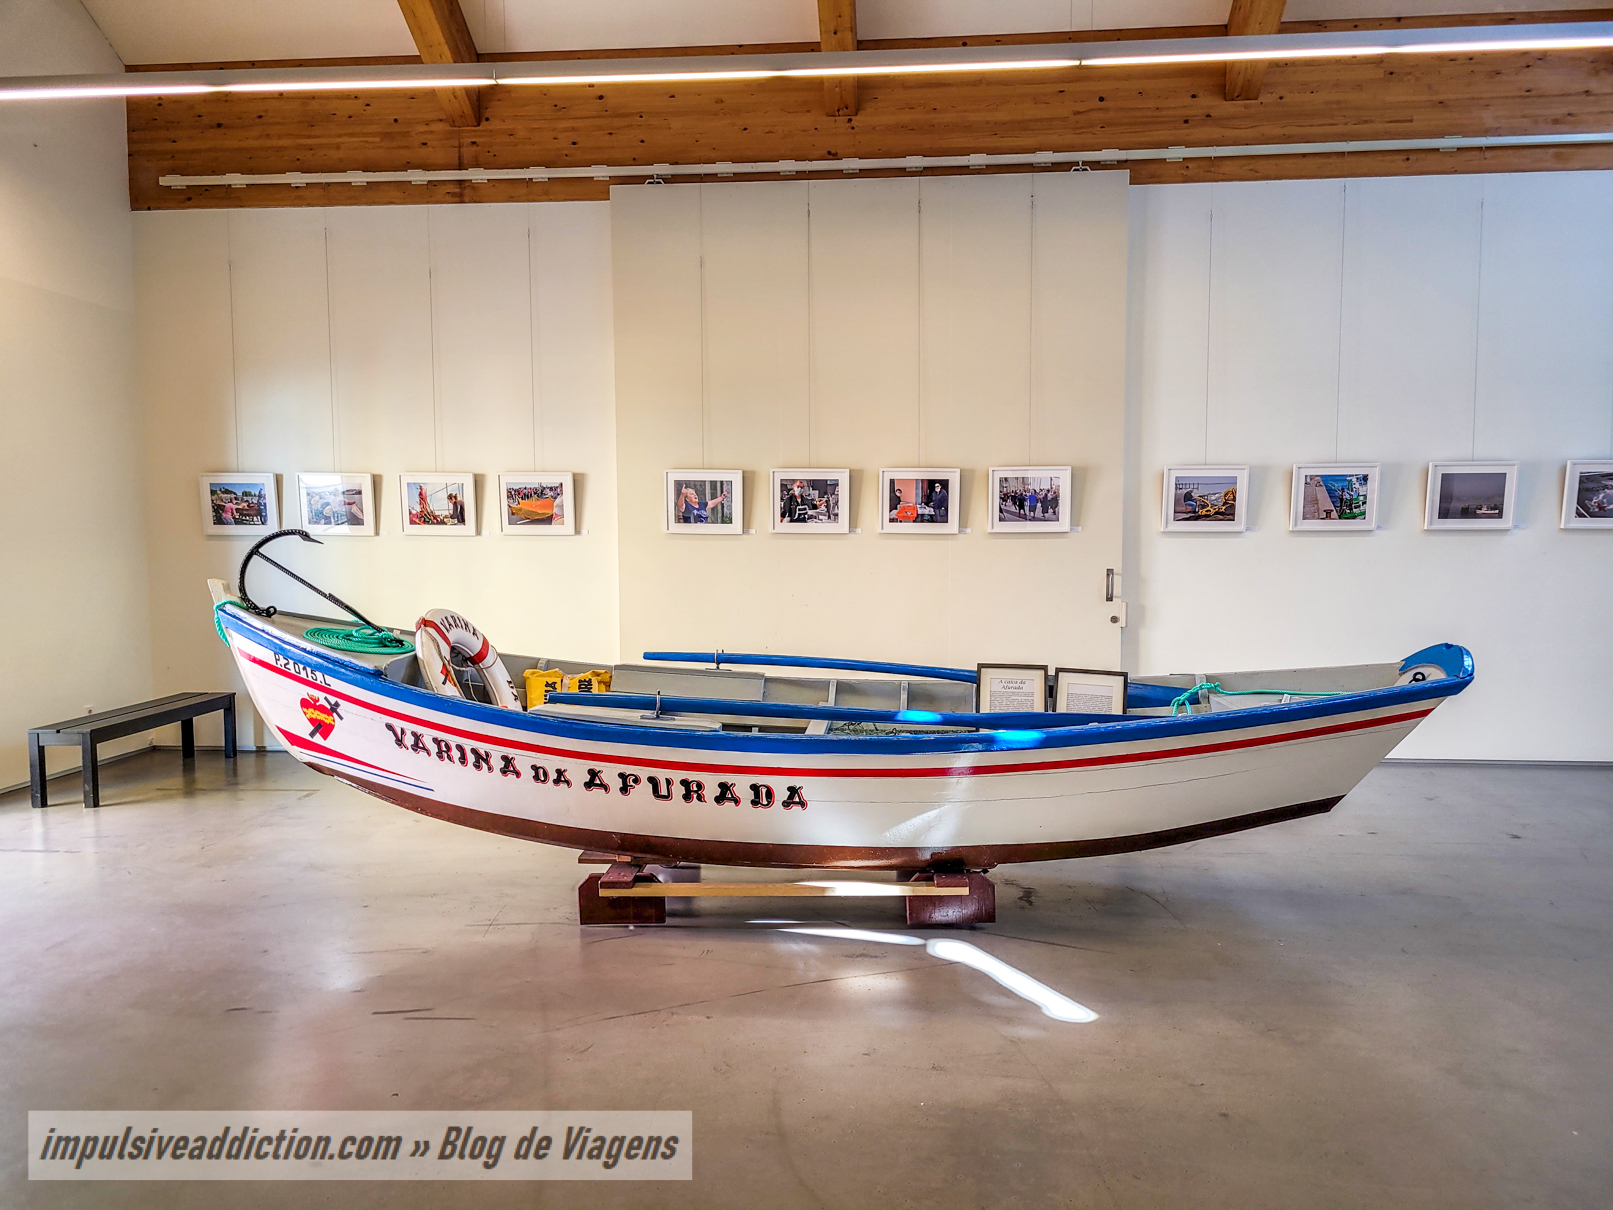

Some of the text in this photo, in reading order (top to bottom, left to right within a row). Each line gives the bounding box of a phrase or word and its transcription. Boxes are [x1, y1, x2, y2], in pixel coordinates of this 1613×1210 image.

[440, 614, 480, 641] VARINA
[385, 722, 808, 811] VARINA DA AFURADA
